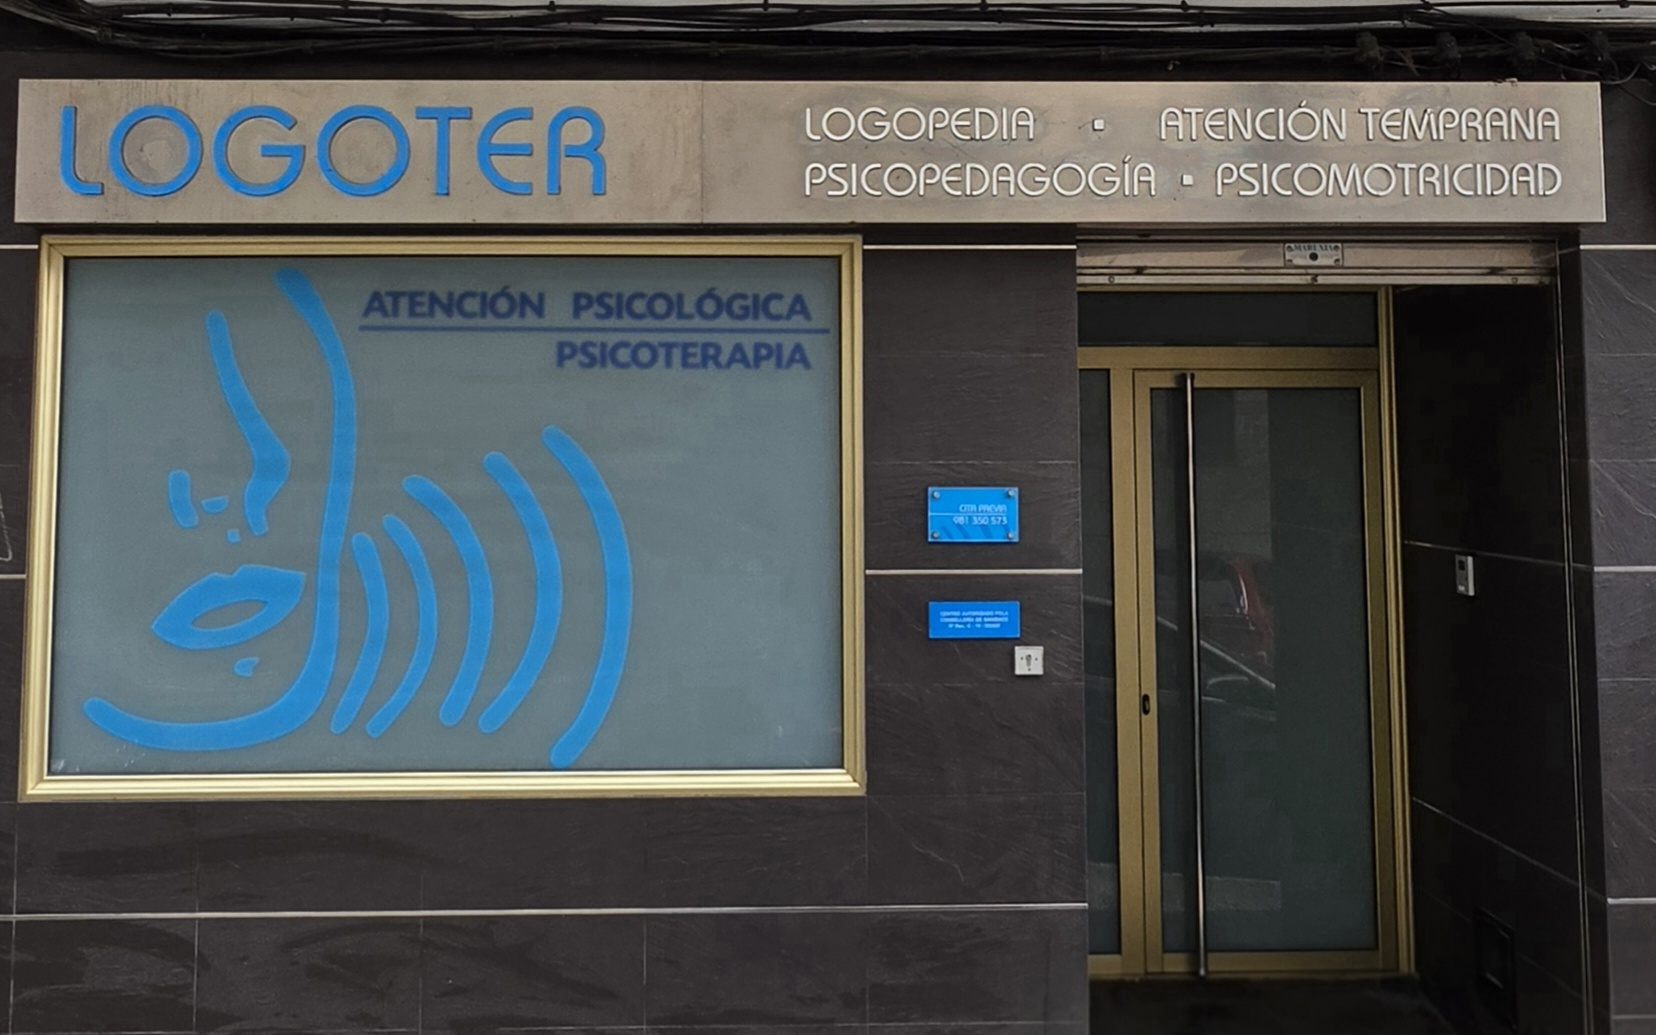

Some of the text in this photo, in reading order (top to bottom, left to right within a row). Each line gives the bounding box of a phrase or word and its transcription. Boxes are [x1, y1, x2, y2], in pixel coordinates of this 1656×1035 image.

[805, 100, 1562, 142] LOGOPEDIA ATENCIÓN TEMPRANA
[60, 104, 608, 197] LOGOTER
[805, 155, 1563, 199] PSICOPEDAGOGÍA PSICOMOTRICIDAD
[362, 286, 811, 321] ATENCIÓN PSICOLÓGICA
[556, 341, 811, 371] PSICOTERAPIA
[953, 516, 1008, 525] 981 350 573
[959, 504, 1007, 513] CITA PREVIA
